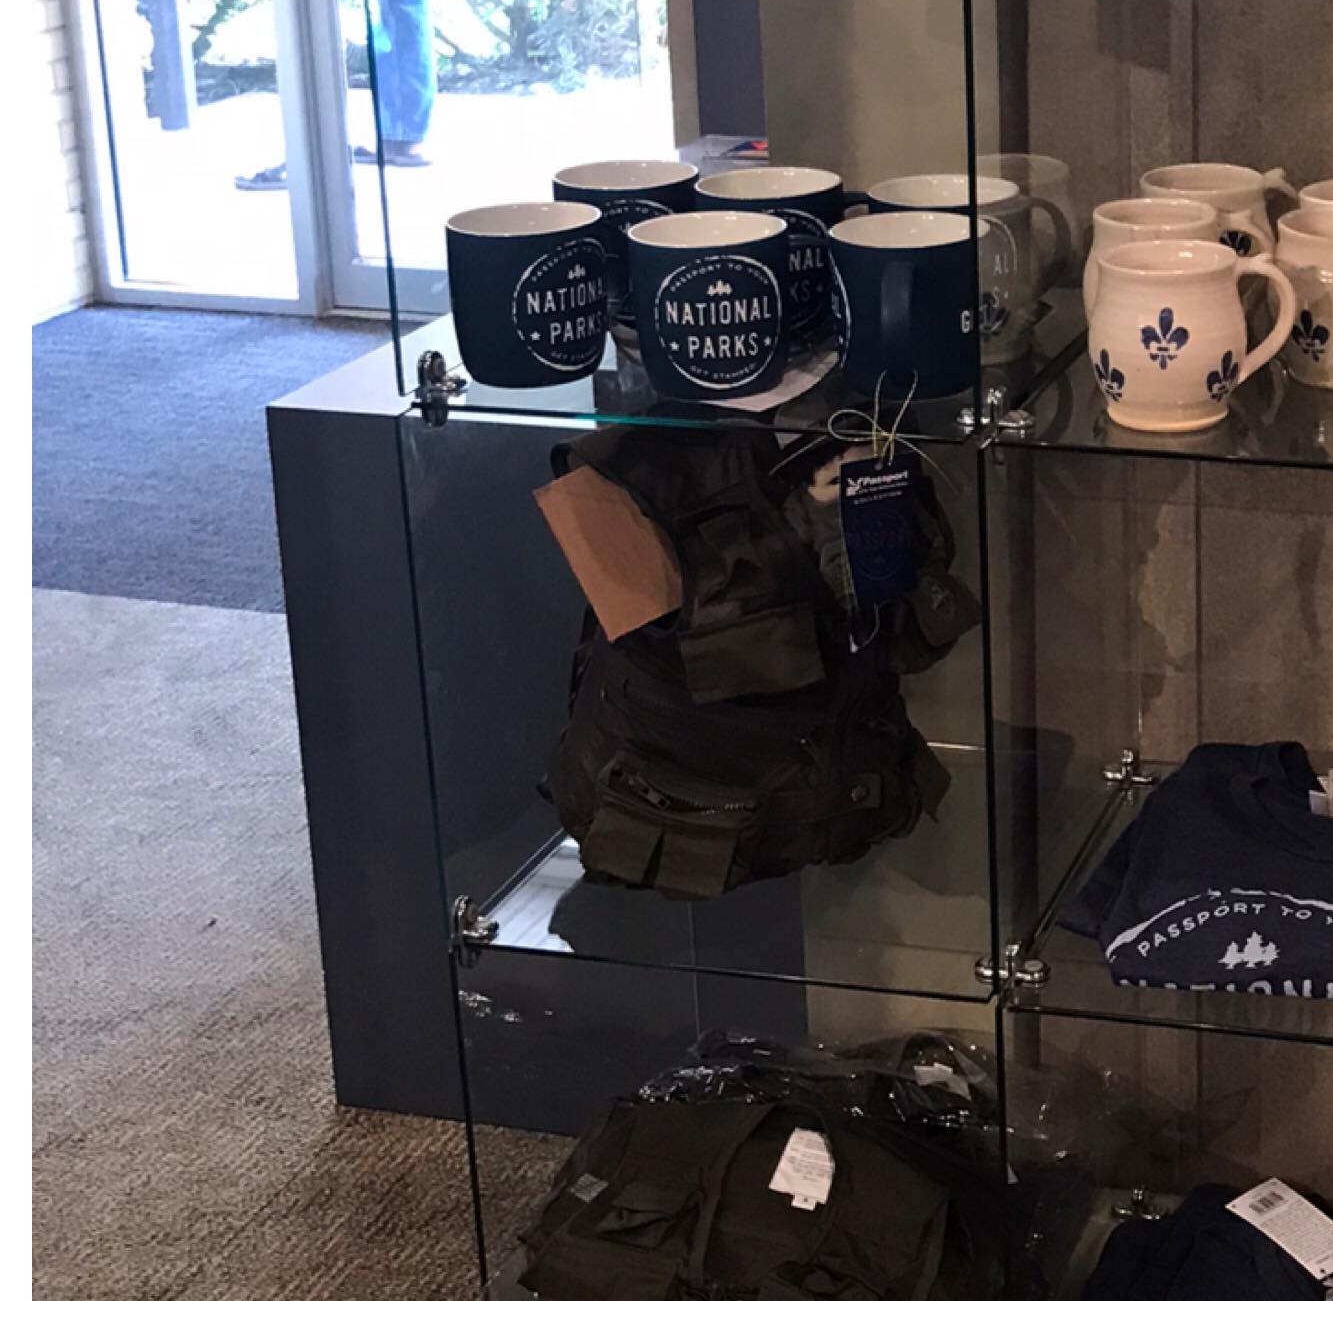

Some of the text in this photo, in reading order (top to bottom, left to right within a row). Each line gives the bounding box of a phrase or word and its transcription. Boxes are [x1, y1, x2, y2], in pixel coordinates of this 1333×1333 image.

[666, 296, 772, 327] NATIONAL
[687, 334, 759, 360] PARKS
[1136, 901, 1266, 959] PASSPORT
[1280, 905, 1312, 921] TO
